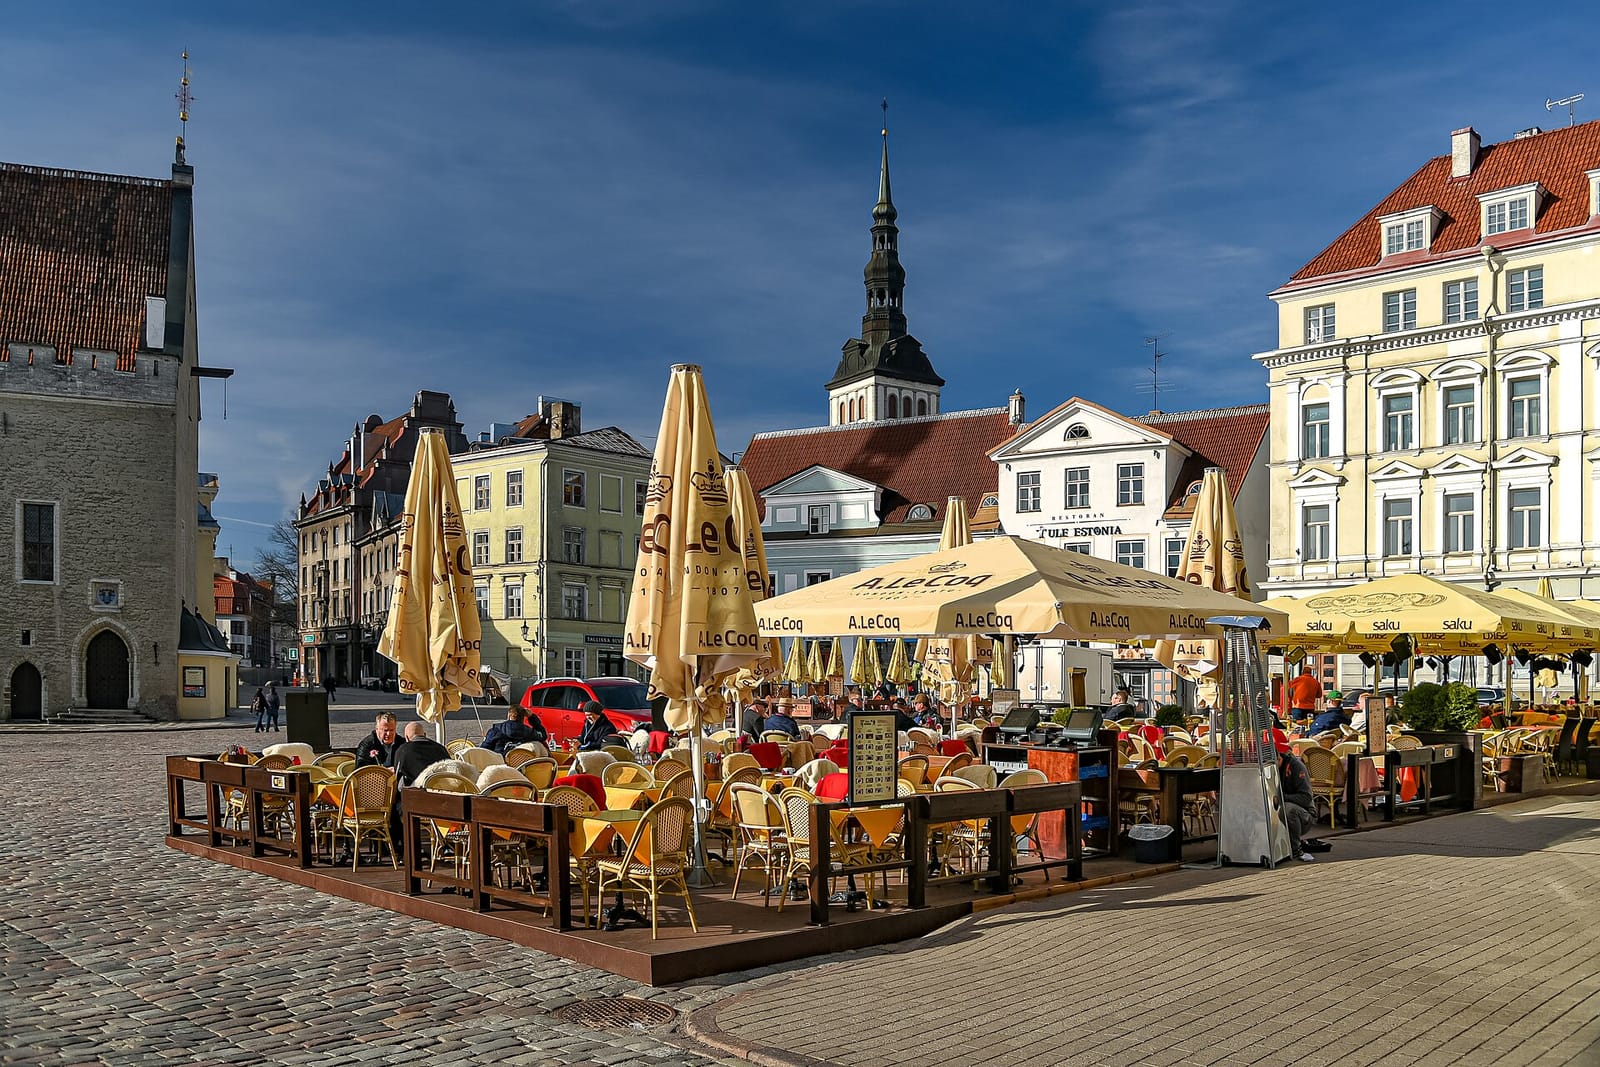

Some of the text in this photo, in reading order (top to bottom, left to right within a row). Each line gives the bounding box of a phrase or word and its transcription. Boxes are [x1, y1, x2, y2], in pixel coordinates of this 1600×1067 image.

[1051, 513, 1105, 521] RESTORAN
[1073, 526, 1122, 537] ESTONIA
[852, 574, 993, 588] A.LeCoq
[706, 586, 739, 596] 1807
[758, 616, 803, 633] A.LeCoq
[848, 614, 900, 632] A.LeCoq
[955, 612, 1013, 630] A.LeCoq
[1089, 611, 1130, 631] A.LeCoq
[1169, 614, 1206, 632] A.LeCoq
[1306, 619, 1332, 631] saku
[1372, 618, 1400, 631] saku
[1442, 617, 1472, 630] saku
[698, 630, 759, 650] A.LeCoq
